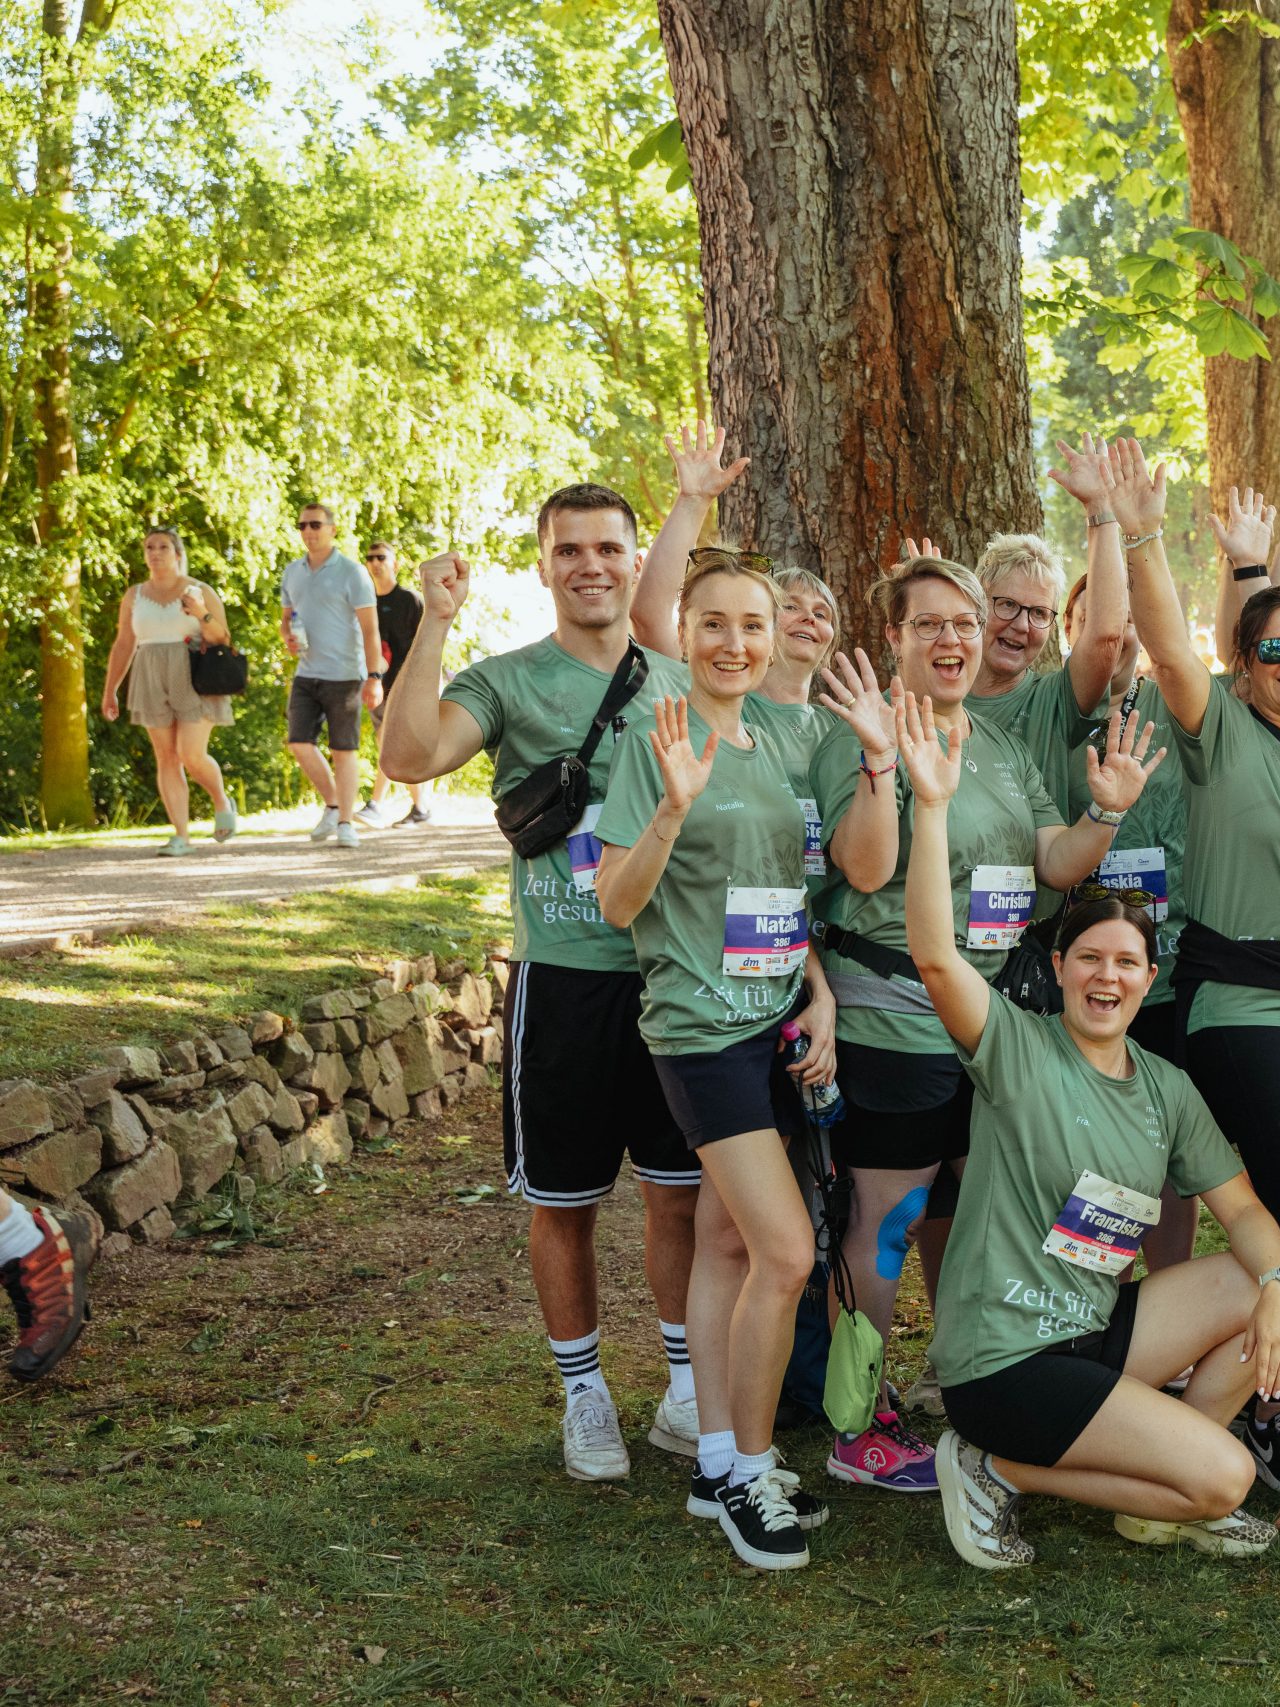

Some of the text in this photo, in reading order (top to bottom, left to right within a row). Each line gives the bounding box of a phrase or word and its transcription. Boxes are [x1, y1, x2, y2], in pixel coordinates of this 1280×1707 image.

[523, 873, 558, 899] Zeit
[1098, 873, 1143, 889] askia
[988, 892, 1031, 910] Christine
[755, 914, 799, 934] Natalia
[985, 931, 998, 941] dm
[743, 957, 760, 967] dm
[1080, 1202, 1144, 1238] Franziska
[1064, 1241, 1079, 1253] dm
[1003, 1278, 1096, 1322] Zeit für
